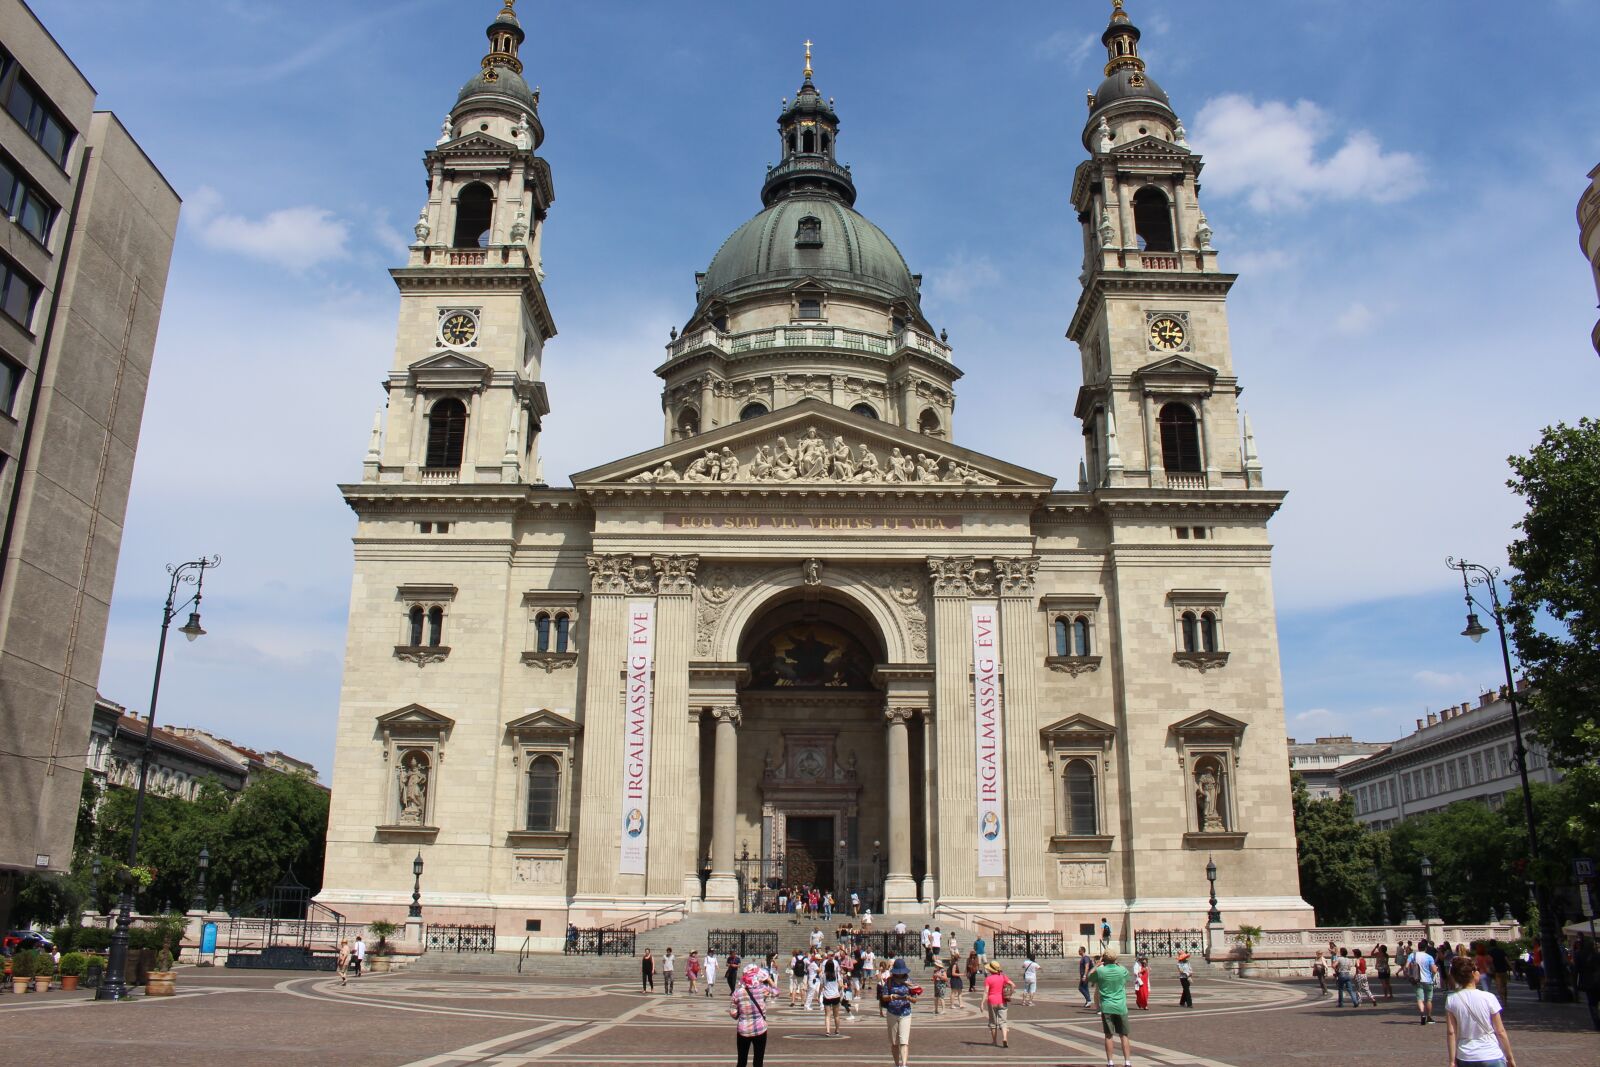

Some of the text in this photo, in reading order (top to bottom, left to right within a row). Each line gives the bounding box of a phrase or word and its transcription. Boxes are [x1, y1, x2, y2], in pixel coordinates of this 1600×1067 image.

[681, 516, 945, 530] EGO SUM VIA VERITAS ET VITA
[628, 612, 648, 799] IRGALMASSÁG ÉVE
[975, 615, 997, 802] IRGALMASSÁG ÉVE
